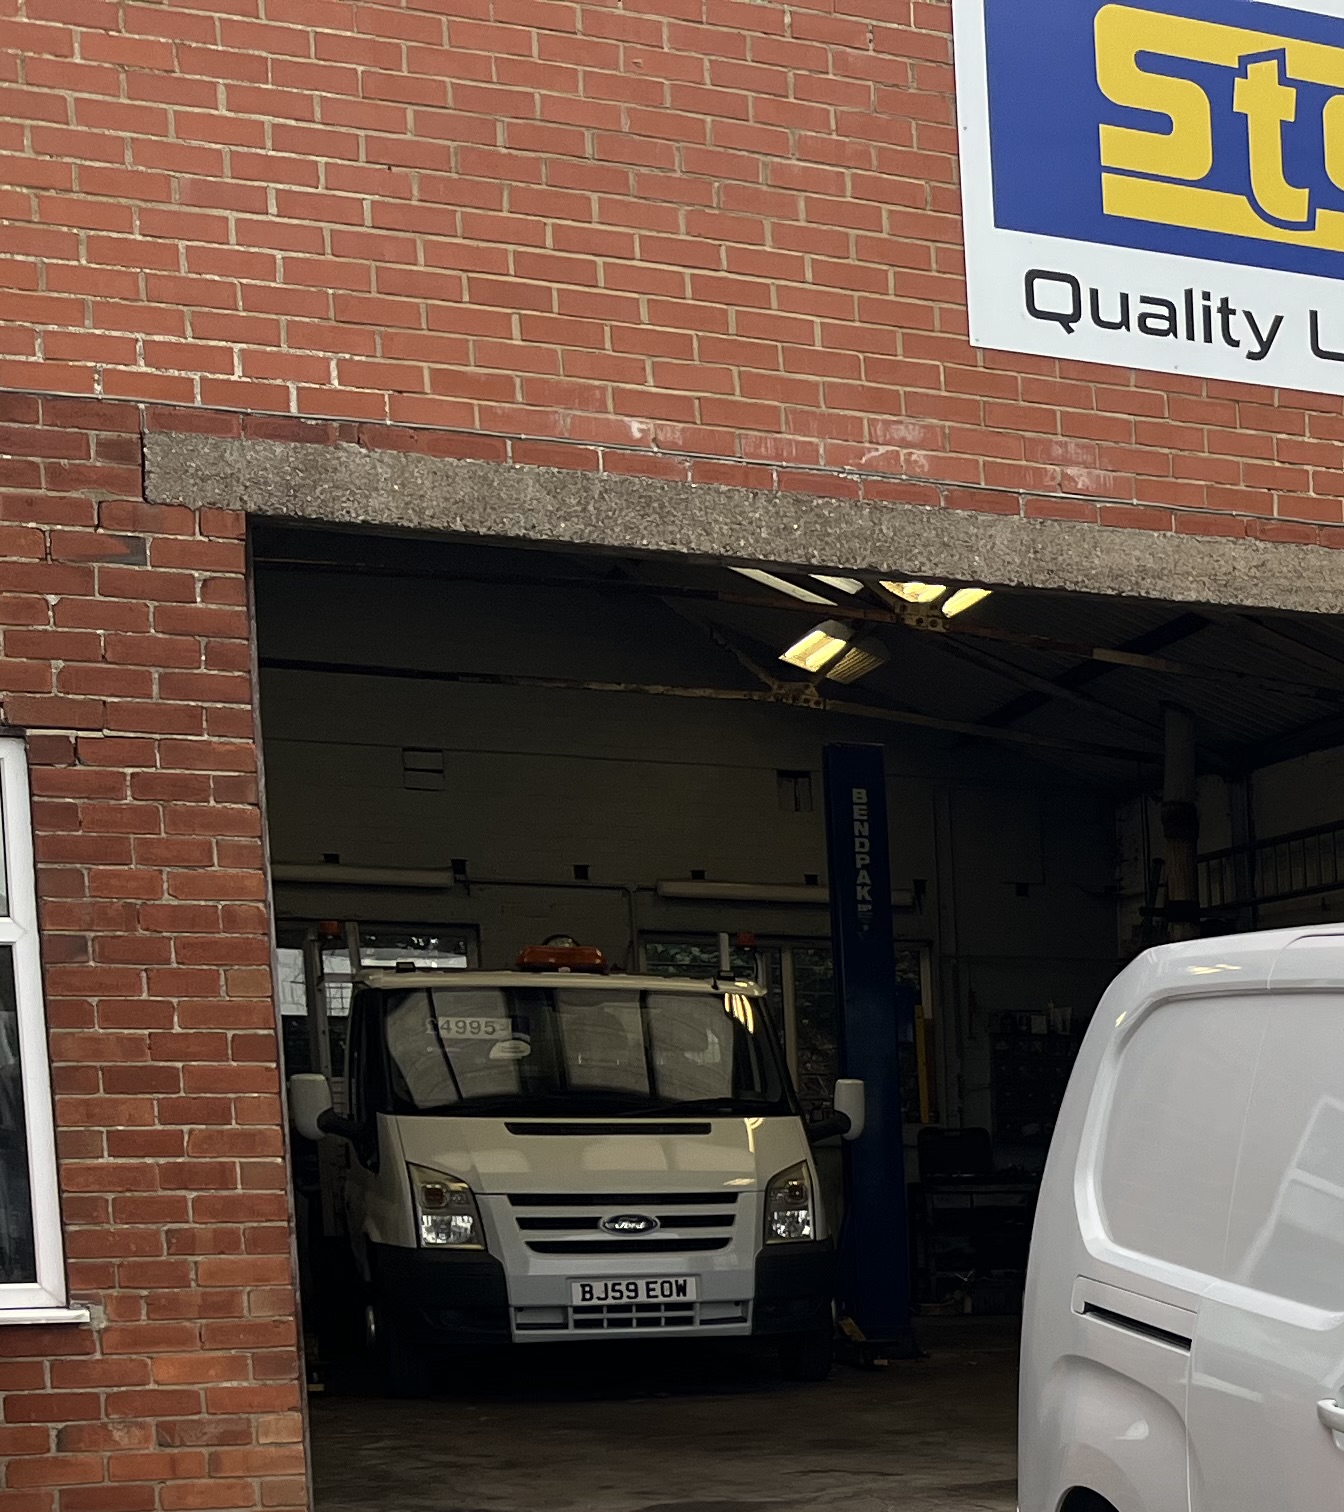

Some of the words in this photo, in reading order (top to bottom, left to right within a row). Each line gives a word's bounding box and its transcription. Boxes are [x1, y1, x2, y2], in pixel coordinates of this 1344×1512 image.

[1024, 268, 1284, 362] Quality
[852, 787, 872, 901] BENDPAK
[580, 1281, 639, 1302] BJ59
[645, 1279, 687, 1299] EOW
